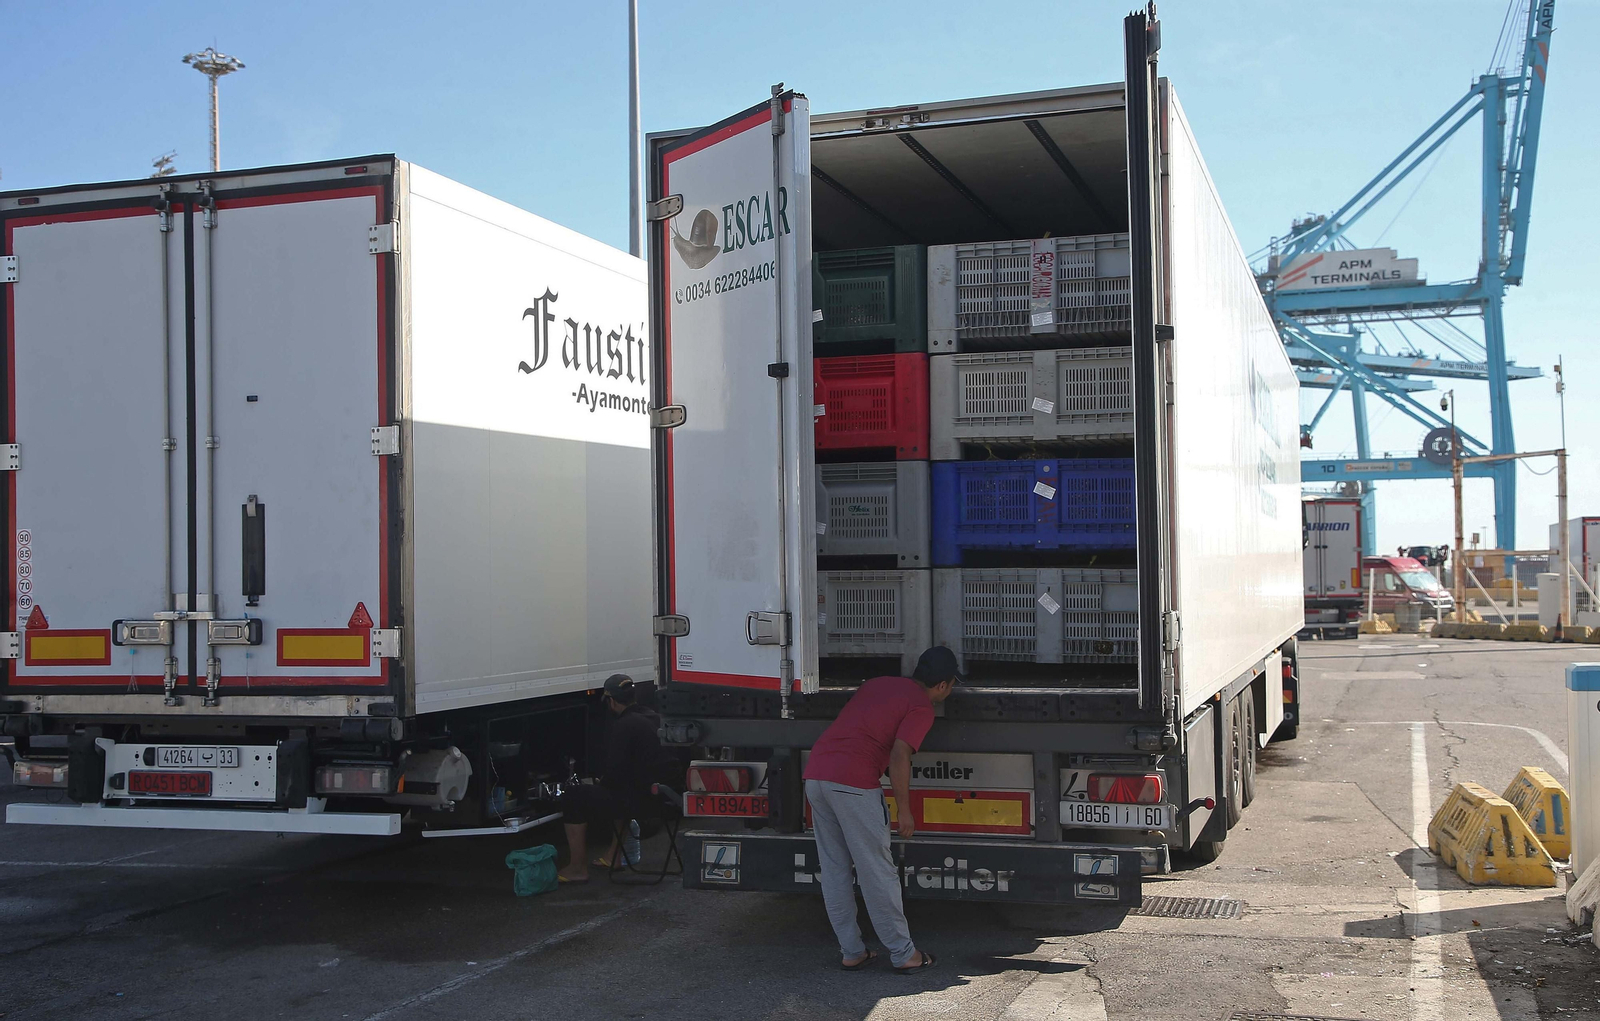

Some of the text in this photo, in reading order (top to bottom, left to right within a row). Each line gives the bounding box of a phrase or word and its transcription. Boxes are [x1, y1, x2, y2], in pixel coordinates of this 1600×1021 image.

[722, 186, 791, 254] ESCAR
[1339, 259, 1373, 270] APM
[1310, 269, 1401, 285] TERMINALS
[685, 279, 712, 303] 0034
[517, 285, 646, 386] Fausti
[1321, 465, 1336, 473] 10
[19, 534, 29, 542] 90
[19, 550, 30, 558] 85
[19, 566, 30, 574] 80
[20, 582, 30, 590] 70
[20, 598, 30, 606] 60
[163, 749, 193, 764] 41264
[219, 749, 233, 763] 33
[133, 775, 142, 790] R
[144, 775, 175, 791] 0451
[695, 797, 705, 813] R
[710, 797, 748, 814] 1894
[1069, 803, 1110, 823] 18856
[1145, 807, 1162, 826] 60
